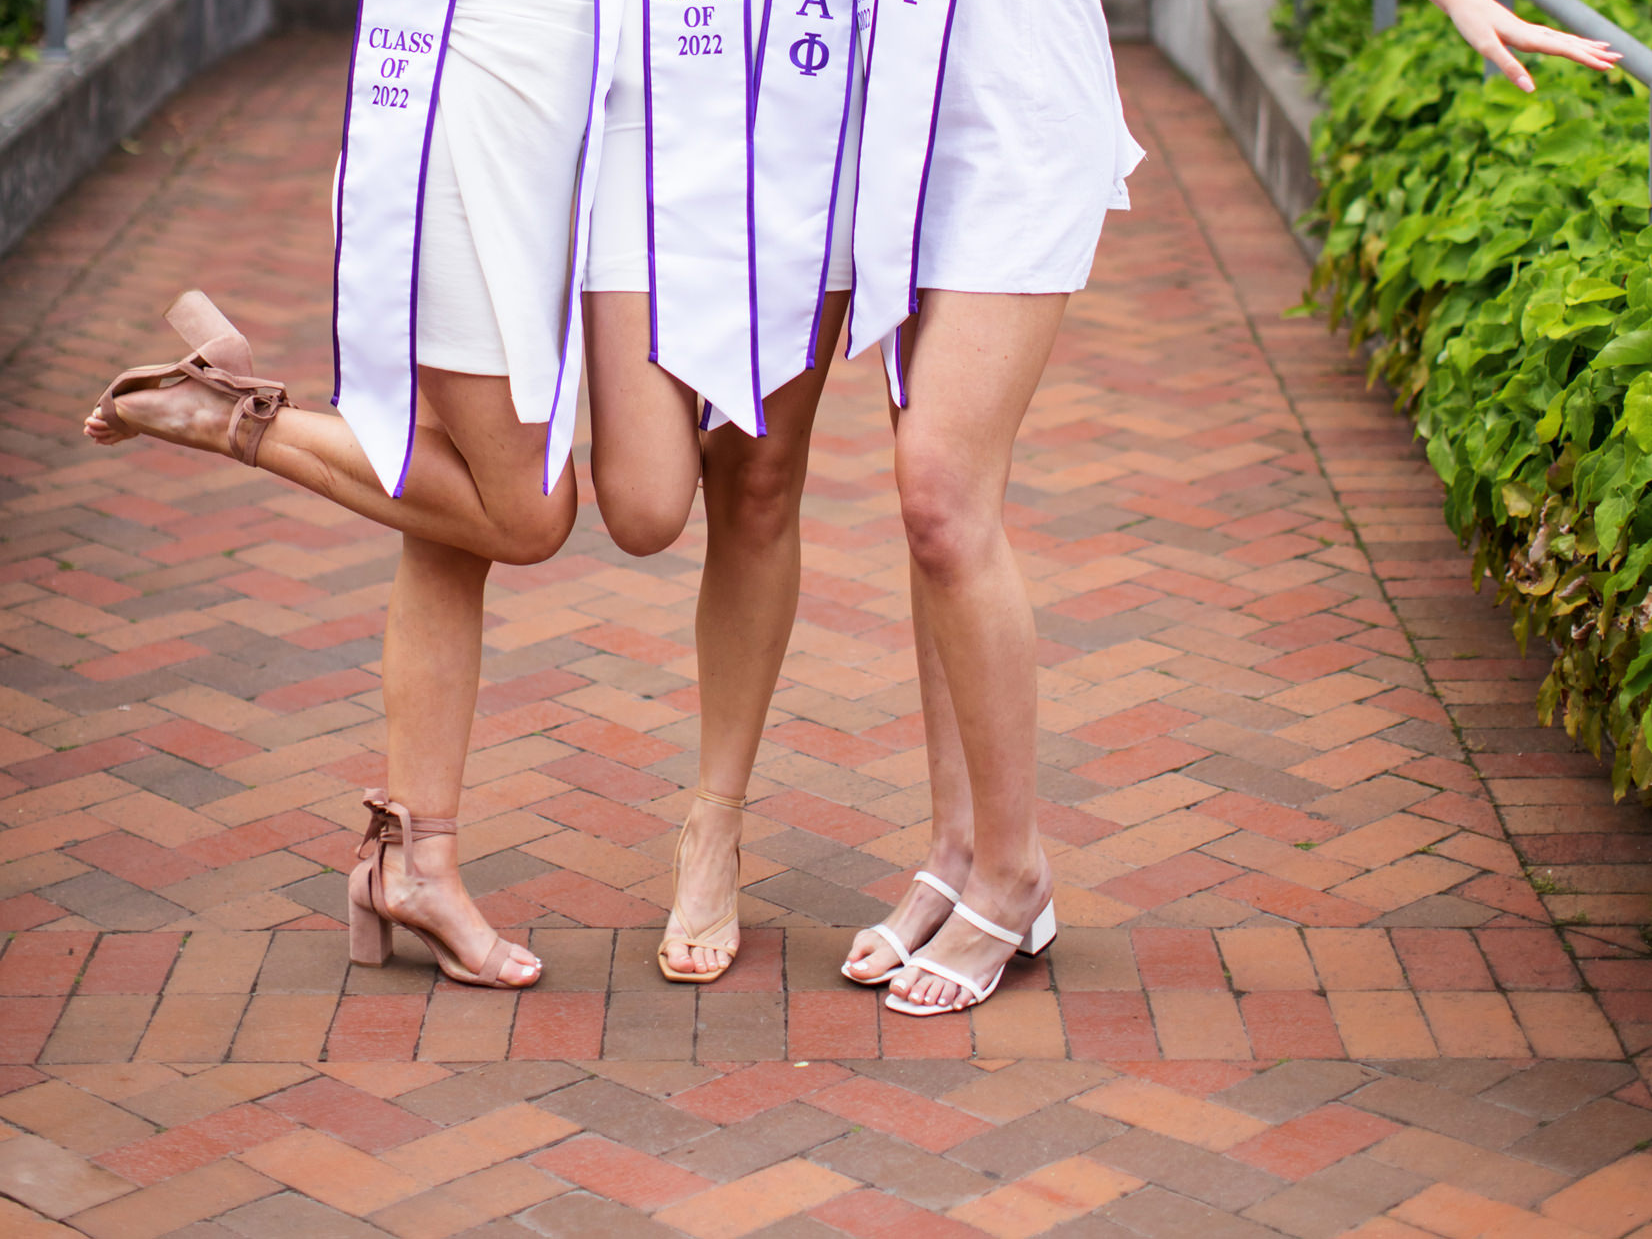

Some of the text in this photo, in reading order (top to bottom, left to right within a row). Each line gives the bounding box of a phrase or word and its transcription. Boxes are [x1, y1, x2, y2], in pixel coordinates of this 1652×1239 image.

[684, 6, 714, 27] OF
[369, 28, 433, 54] CLASS
[678, 34, 722, 55] 2022
[789, 32, 829, 76] Φ
[381, 58, 408, 78] OF
[372, 85, 408, 108] 2022
